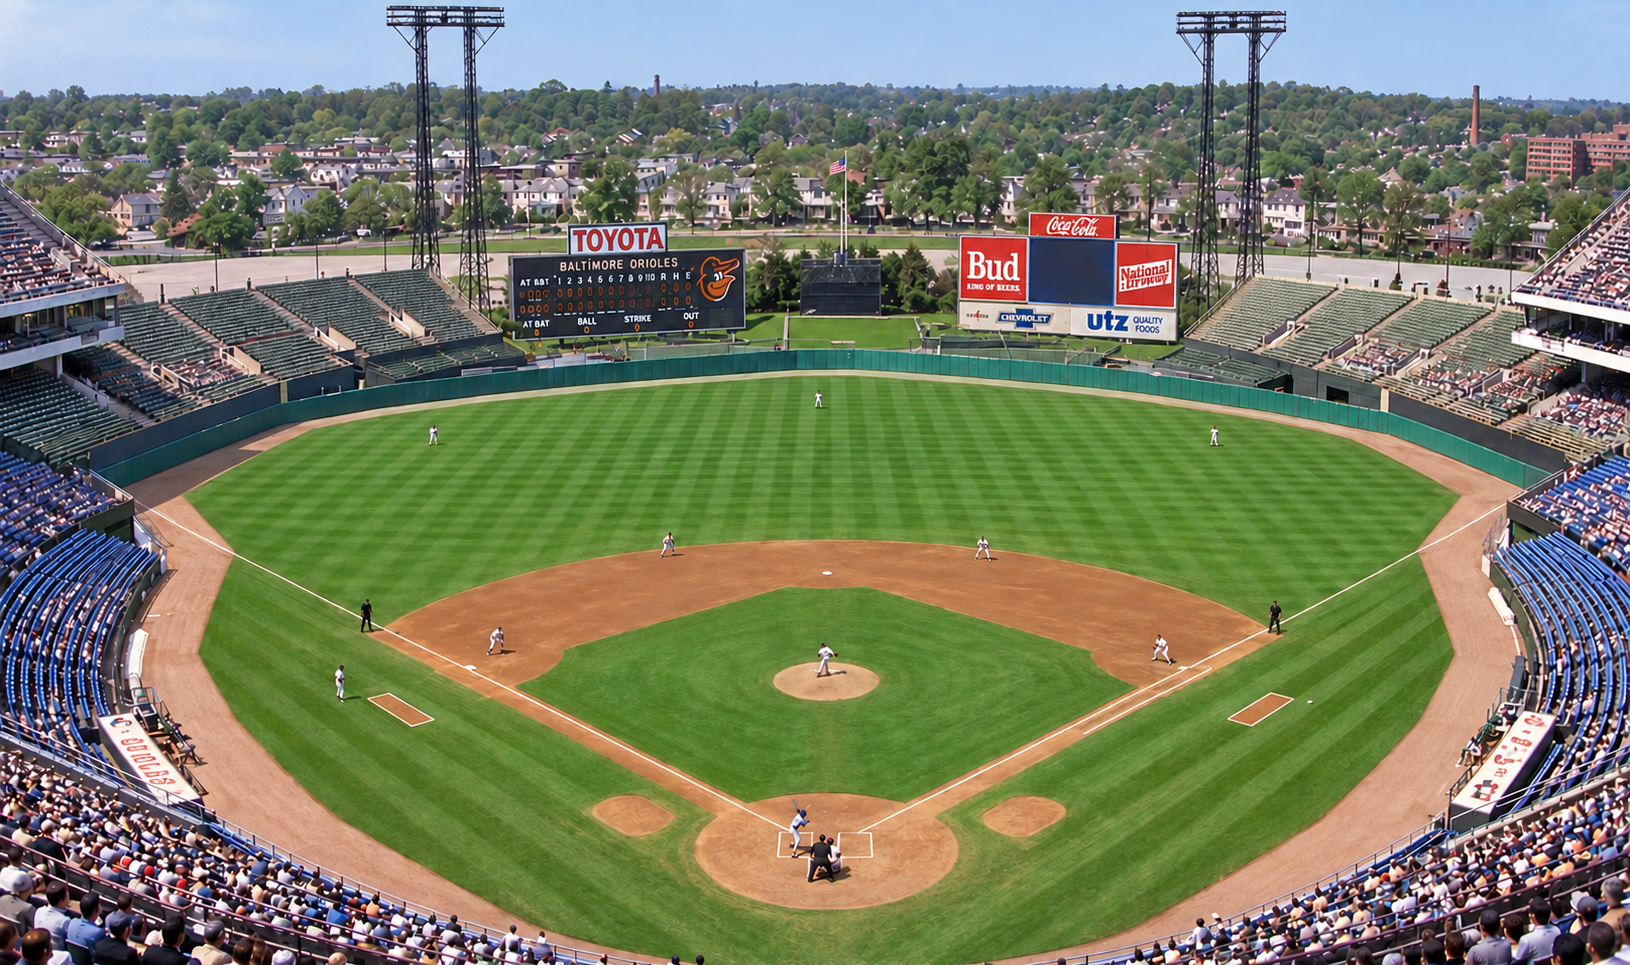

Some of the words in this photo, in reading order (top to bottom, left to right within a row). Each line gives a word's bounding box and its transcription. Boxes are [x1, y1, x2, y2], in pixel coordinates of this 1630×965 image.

[573, 227, 664, 252] TOYOTA
[560, 259, 624, 272] BALTIMORE
[629, 257, 678, 269] ORIOLES
[966, 251, 1020, 281] Bud
[1121, 261, 1170, 281] National
[567, 277, 572, 285] 2
[587, 276, 592, 284] 4
[618, 274, 624, 282] 7
[638, 274, 643, 282] 9
[661, 272, 667, 280] R
[673, 272, 679, 280] H
[985, 283, 995, 291] OF
[624, 314, 652, 323] STRIKE
[683, 312, 700, 320] OUT
[1001, 311, 1048, 322] CHEVROLET
[1133, 316, 1163, 325] QUALITY
[577, 317, 597, 326] BALL
[584, 326, 590, 334] 0
[634, 323, 640, 332] 0
[1135, 325, 1160, 334] FOODS
